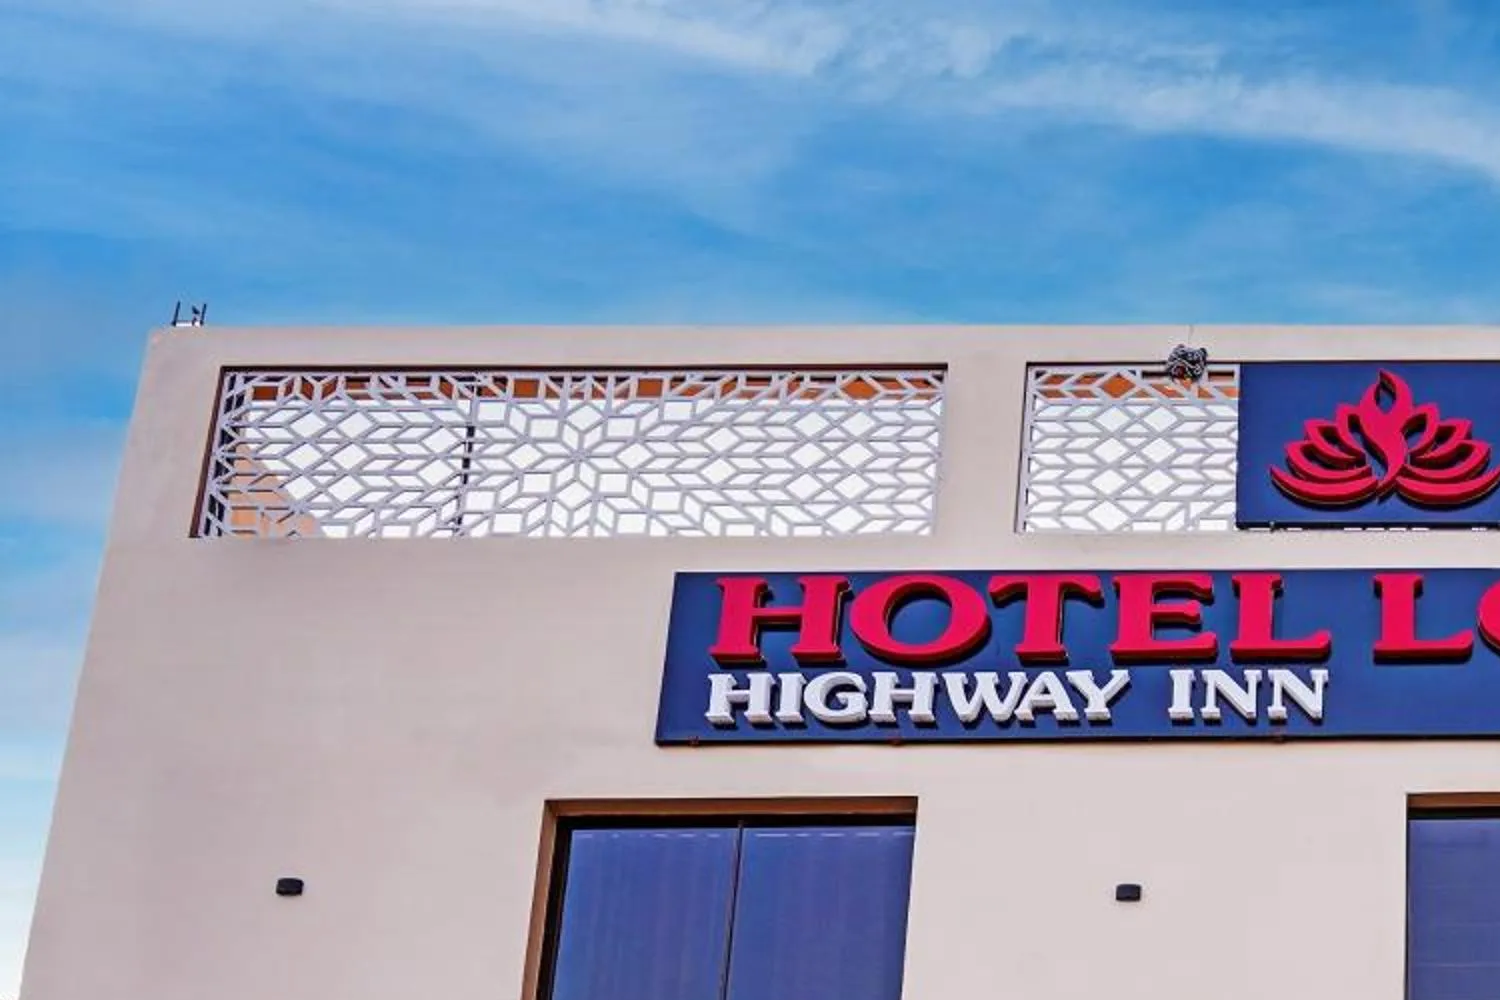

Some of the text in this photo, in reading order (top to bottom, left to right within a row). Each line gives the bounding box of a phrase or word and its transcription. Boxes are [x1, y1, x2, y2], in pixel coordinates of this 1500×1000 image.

[709, 574, 1332, 663] HOTEL
[704, 668, 1330, 726] HIGHWAY INN
